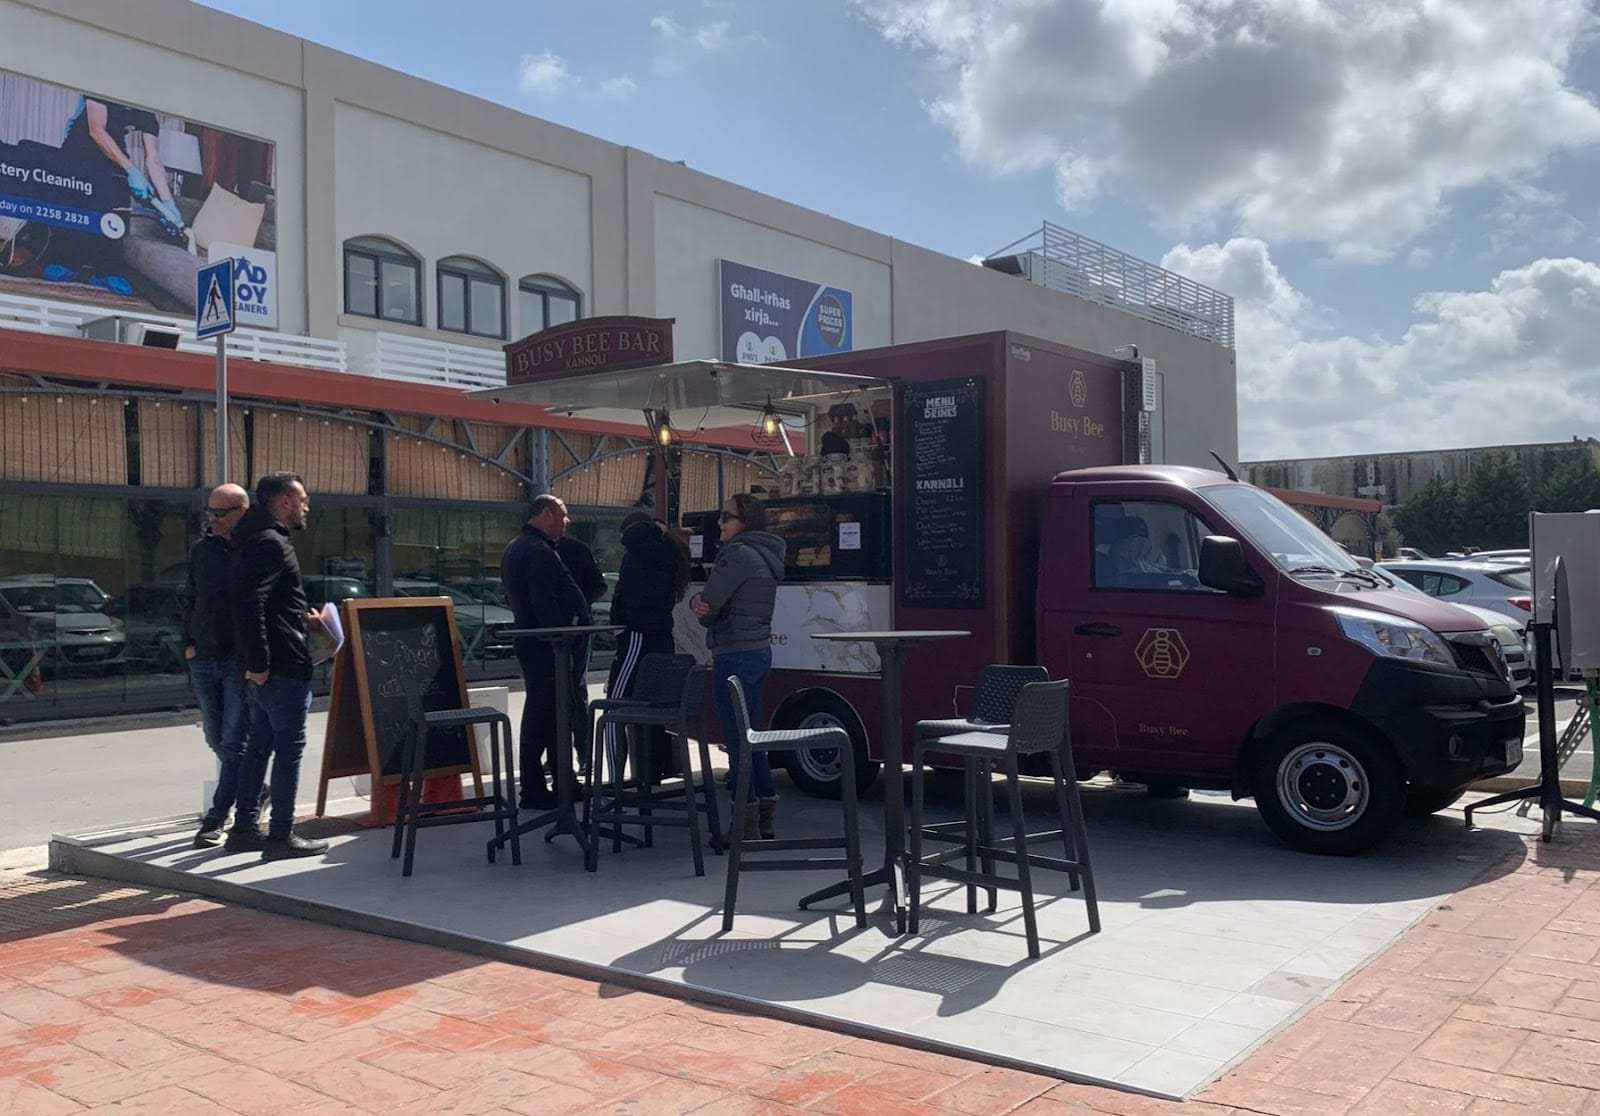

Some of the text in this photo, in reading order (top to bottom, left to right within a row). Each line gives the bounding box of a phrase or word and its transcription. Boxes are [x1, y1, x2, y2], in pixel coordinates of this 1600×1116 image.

[0, 162, 93, 196] tery Cleaning
[20, 204, 33, 214] on
[36, 206, 62, 220] 2258
[64, 211, 90, 226] 2828
[233, 256, 267, 285] AD
[237, 283, 267, 305] OY
[234, 301, 269, 315] EANERS
[819, 304, 842, 318] SUPER
[517, 330, 660, 373] BUSY BEE BAR
[565, 353, 609, 370] KANNOLI
[926, 396, 955, 408] MENU
[924, 407, 957, 419] DRINKS
[1050, 410, 1105, 439] Busy Bee
[916, 477, 964, 490] KANNOLI
[769, 633, 788, 646] ee
[1168, 725, 1190, 736] Bee
